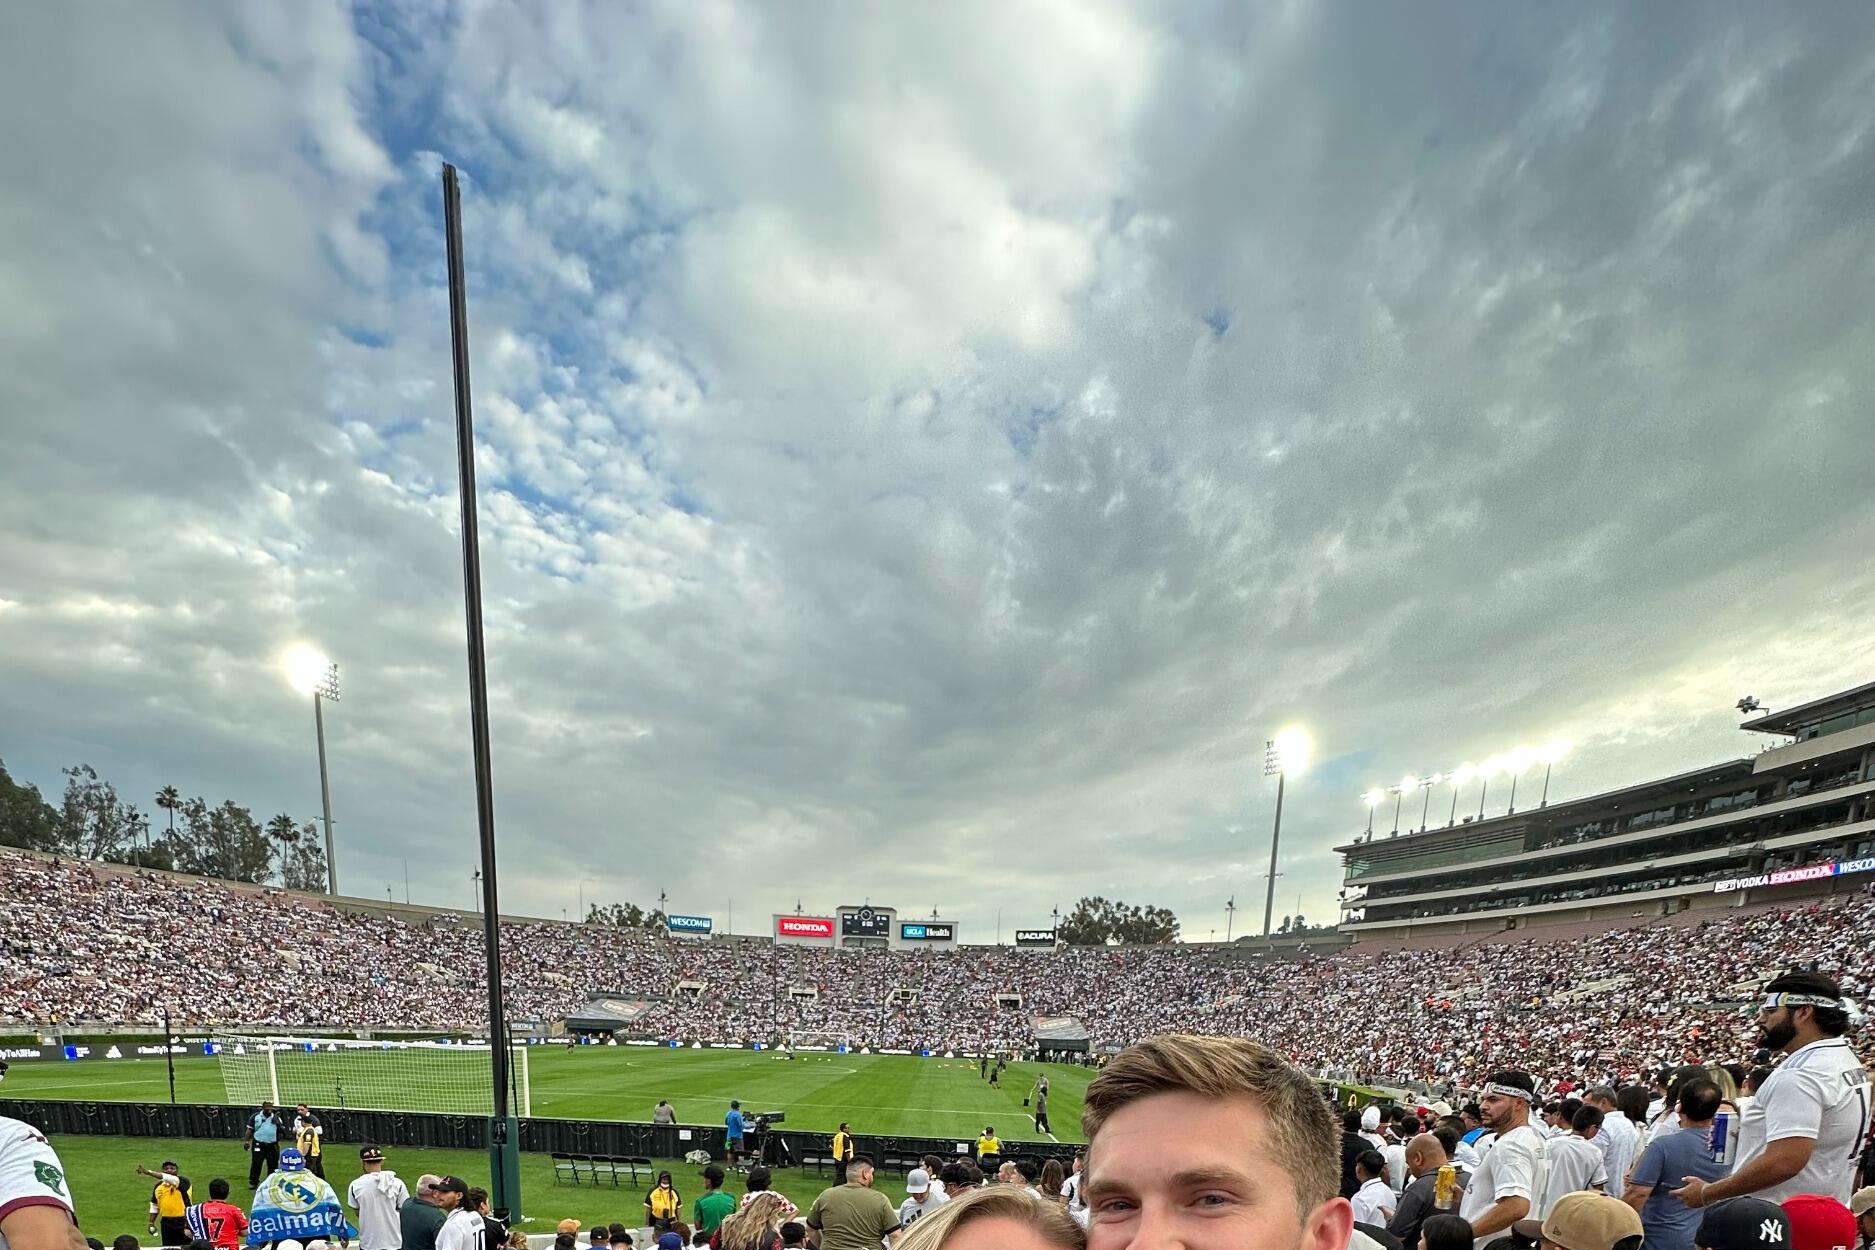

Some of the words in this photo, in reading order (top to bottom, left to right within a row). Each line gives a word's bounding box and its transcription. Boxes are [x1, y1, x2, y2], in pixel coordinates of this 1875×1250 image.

[1770, 866, 1830, 884] HONDA
[1736, 875, 1769, 889] VODKA
[670, 917, 703, 928] WESCOM
[783, 922, 828, 932] HONDA
[926, 928, 950, 937] Health
[1023, 932, 1054, 940] ACURA
[1760, 1219, 1783, 1242] NY
